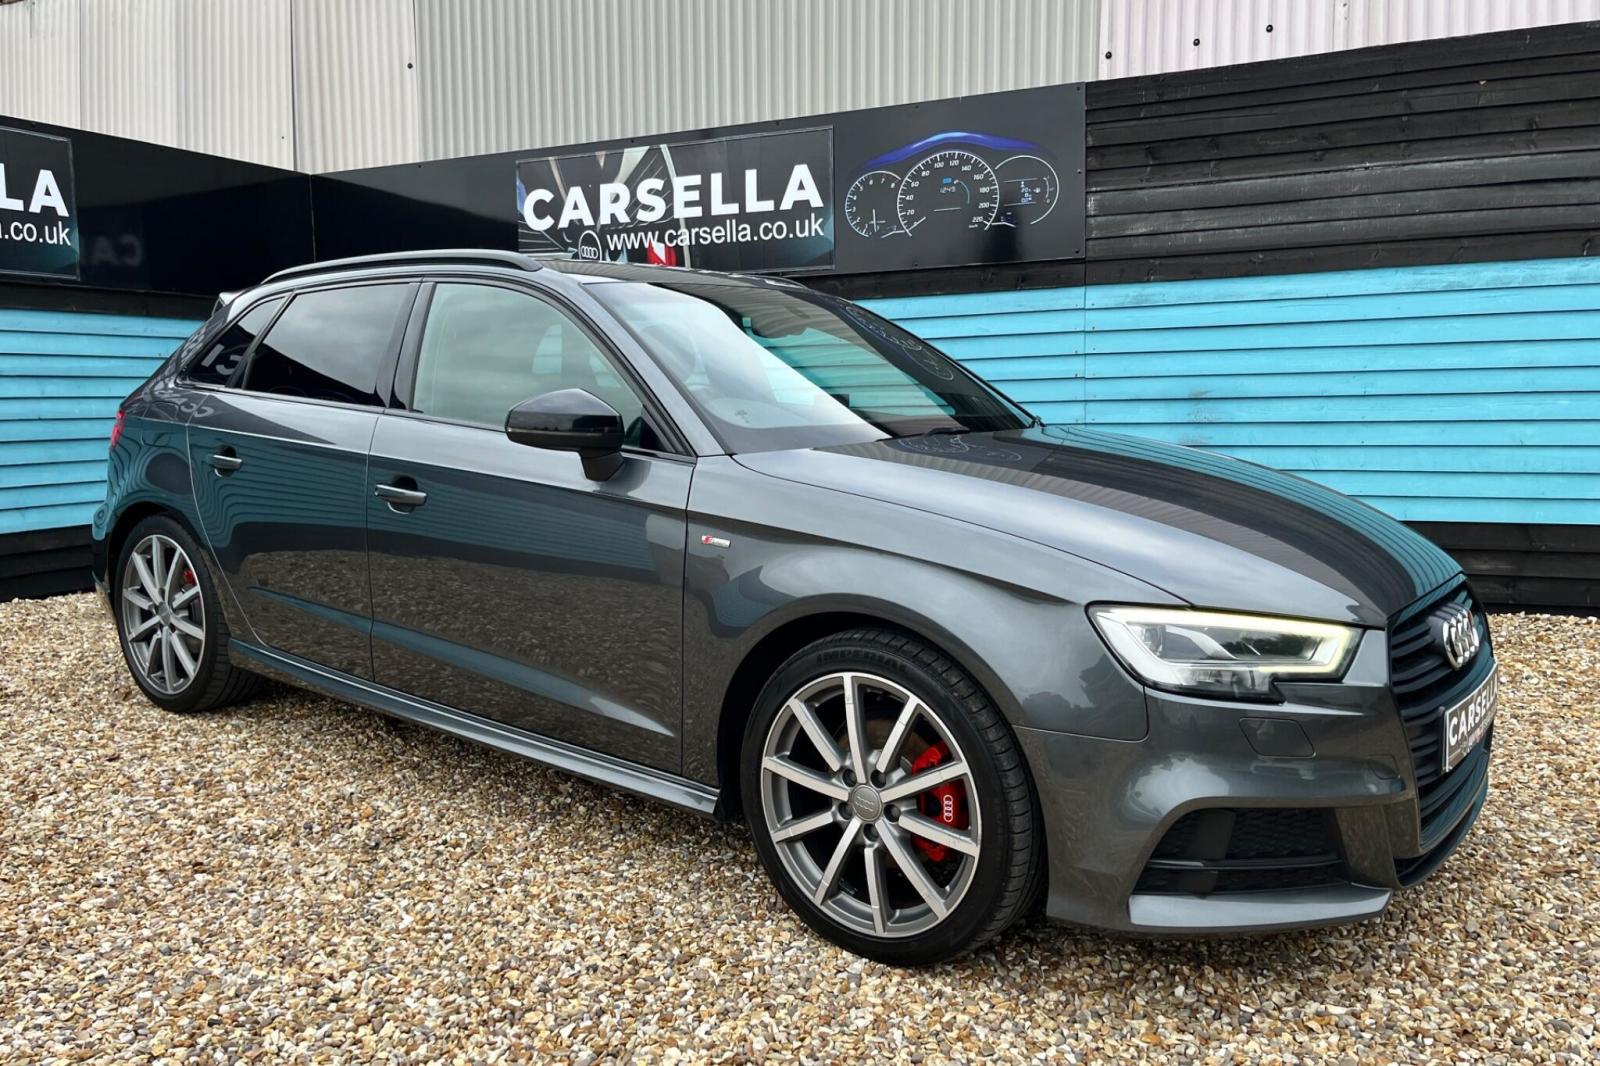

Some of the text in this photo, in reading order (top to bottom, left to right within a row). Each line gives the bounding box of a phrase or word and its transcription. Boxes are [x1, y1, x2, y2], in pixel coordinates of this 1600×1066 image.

[934, 161, 945, 169] 100
[949, 159, 959, 167] 120
[973, 173, 984, 181] 160
[523, 163, 824, 231] CARSELLA
[0, 219, 71, 246] .co.uk
[606, 213, 824, 250] www.carsella.co.uk
